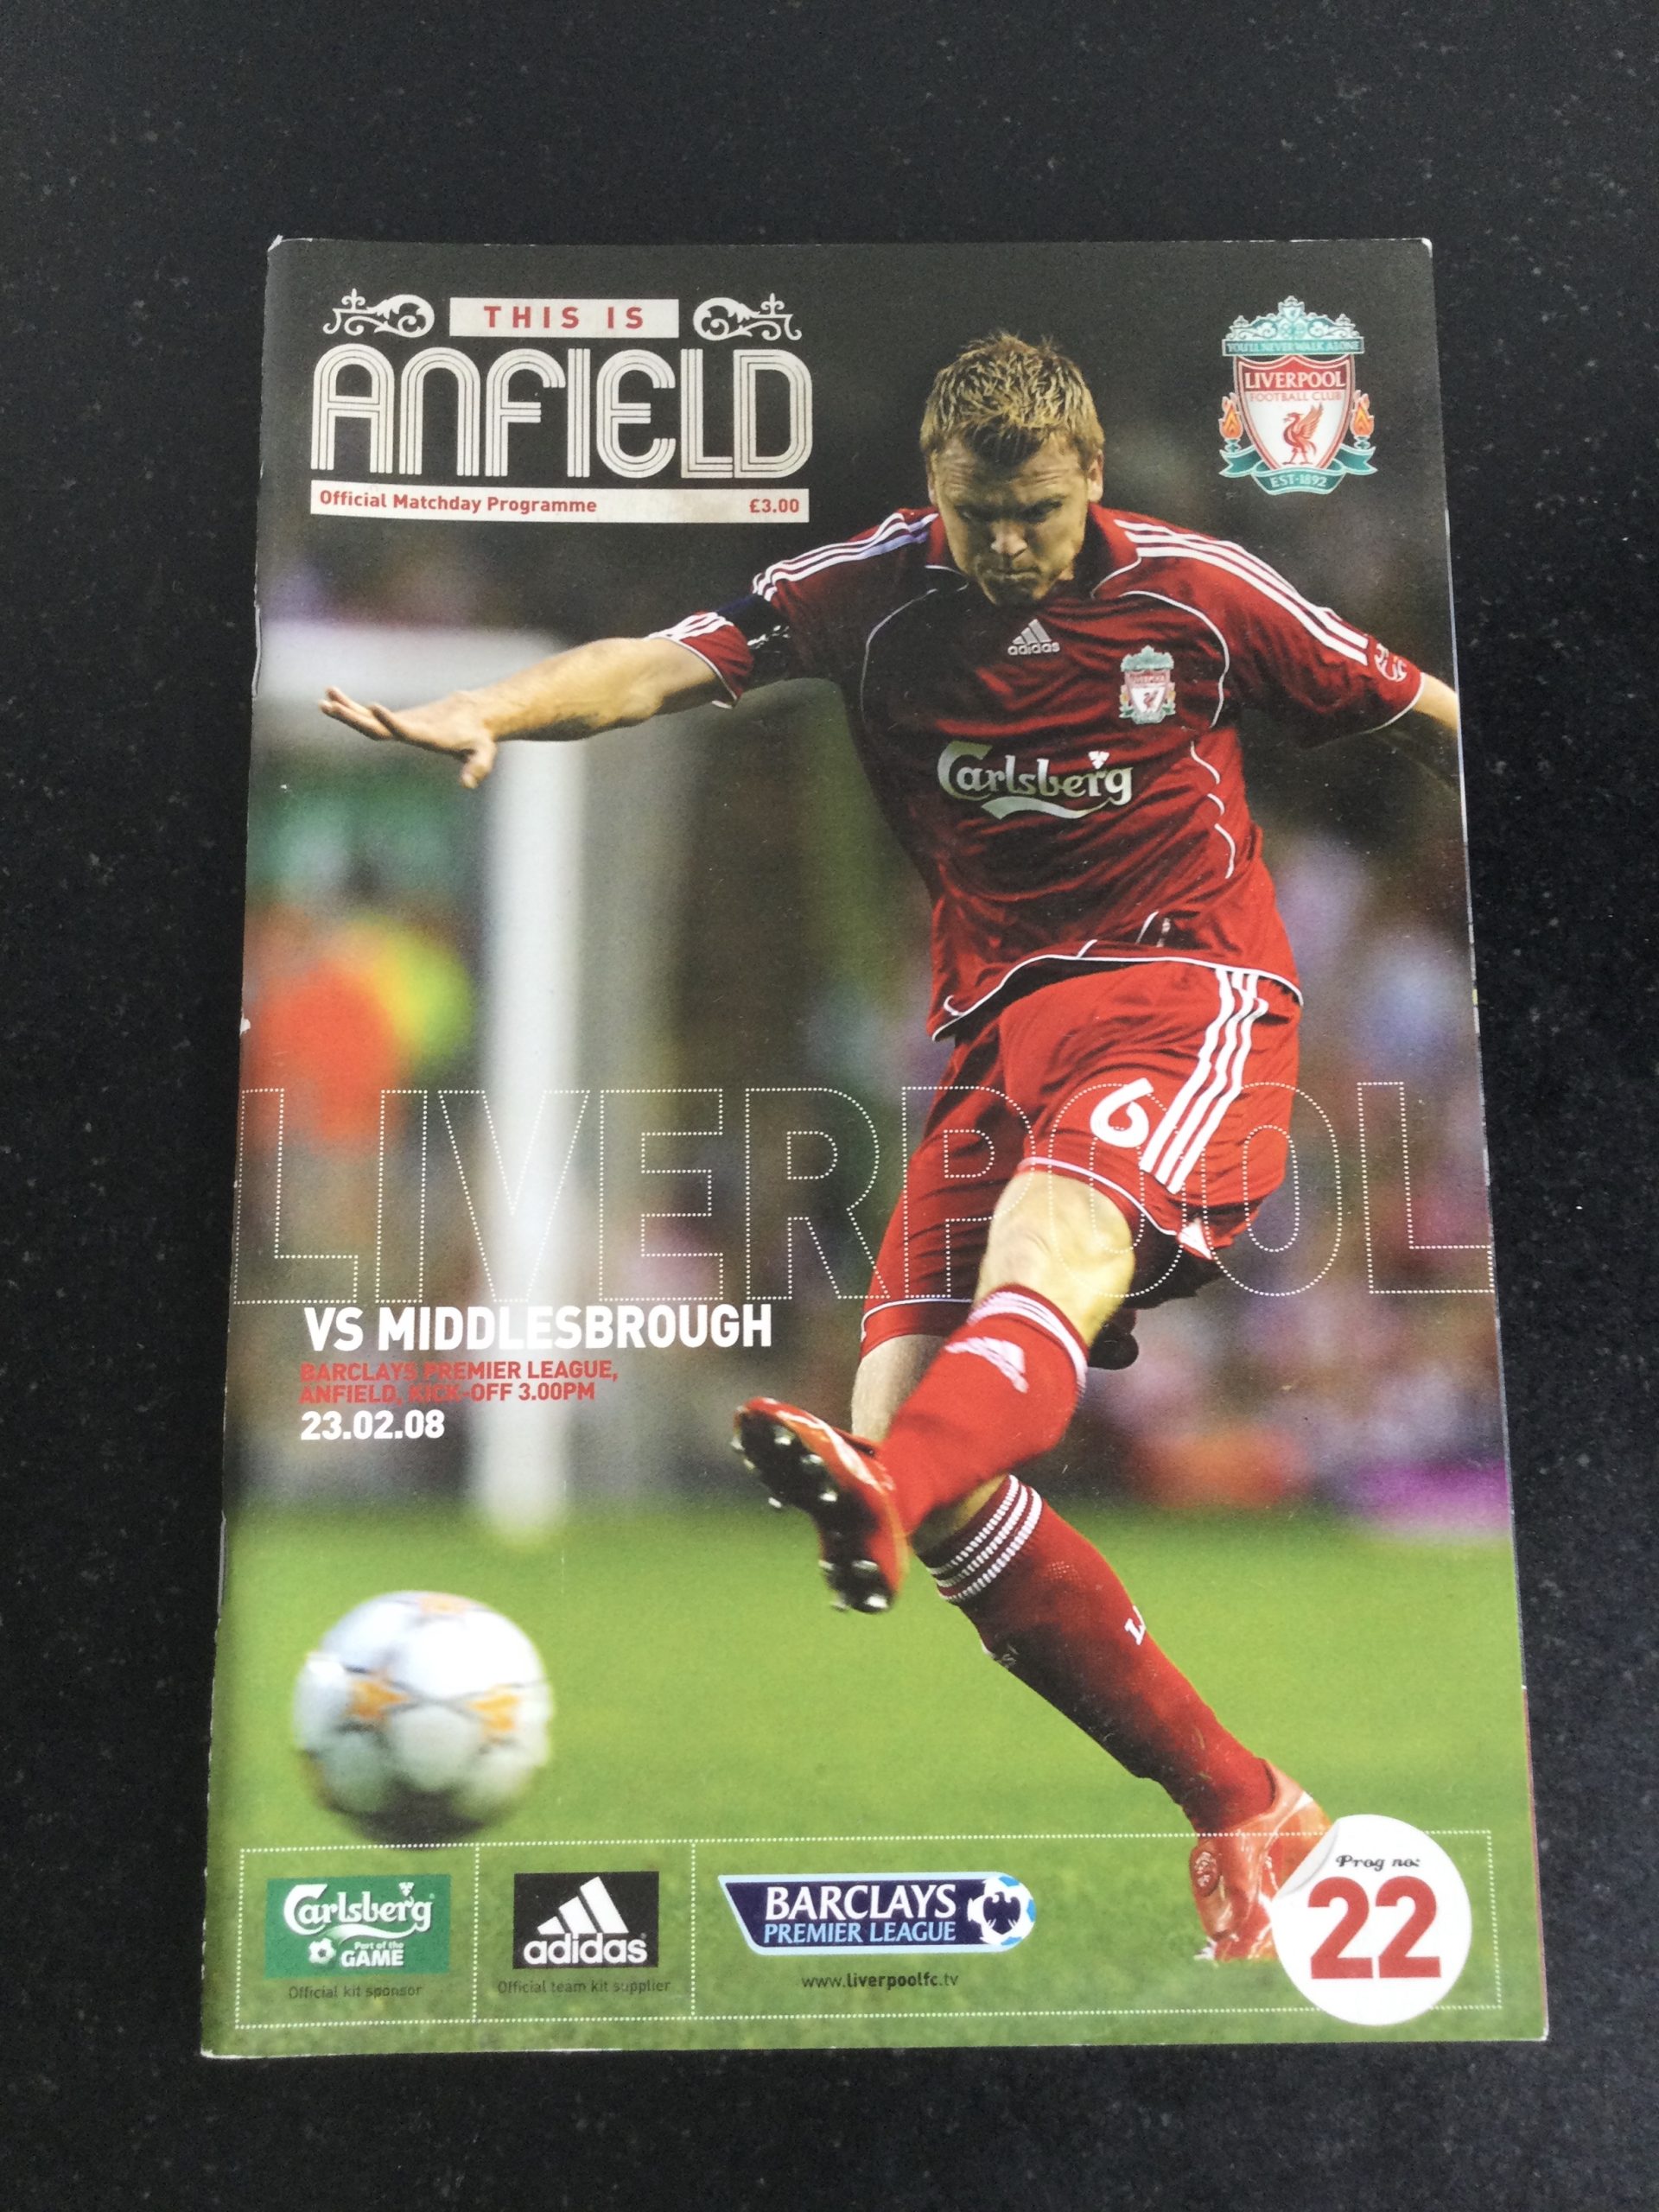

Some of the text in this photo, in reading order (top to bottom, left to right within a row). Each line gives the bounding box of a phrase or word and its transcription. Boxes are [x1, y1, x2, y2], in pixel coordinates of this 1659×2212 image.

[484, 305, 645, 329] THIS IS
[1244, 371, 1346, 389] LIVERPOOL
[1249, 391, 1343, 402] FOOTBALL CLUB
[309, 343, 813, 479] ANFIELD
[319, 489, 800, 515] Official Matchday Programme £3.00
[1007, 640, 1060, 656] adidas
[937, 740, 1135, 805] Carlsberg
[1090, 1077, 1154, 1147] 6
[233, 1082, 1496, 1306] LIVERPOOL
[304, 1303, 772, 1352] VS MIDDLESBROUGH
[299, 1359, 619, 1382] BARCLAYS PREMIER LEAGUE,
[298, 1382, 595, 1406] ANFIELD, KICK-OFF 3.00PM
[301, 1408, 446, 1441] 23.02.08
[1335, 1854, 1386, 1872] Prog
[283, 1883, 434, 1936] Carlsberg
[765, 1884, 957, 1921] BARCLAYS
[764, 1921, 957, 1944] PREMIER LEAGUE
[1307, 1875, 1441, 1980] 22
[340, 1948, 405, 1967] GAME
[522, 1932, 648, 1966] adidas
[289, 1985, 423, 1999] Official kit sponsor
[497, 1979, 671, 1995] Official team kit supplier
[801, 1971, 959, 1991] www.liverpoolfc.tv
